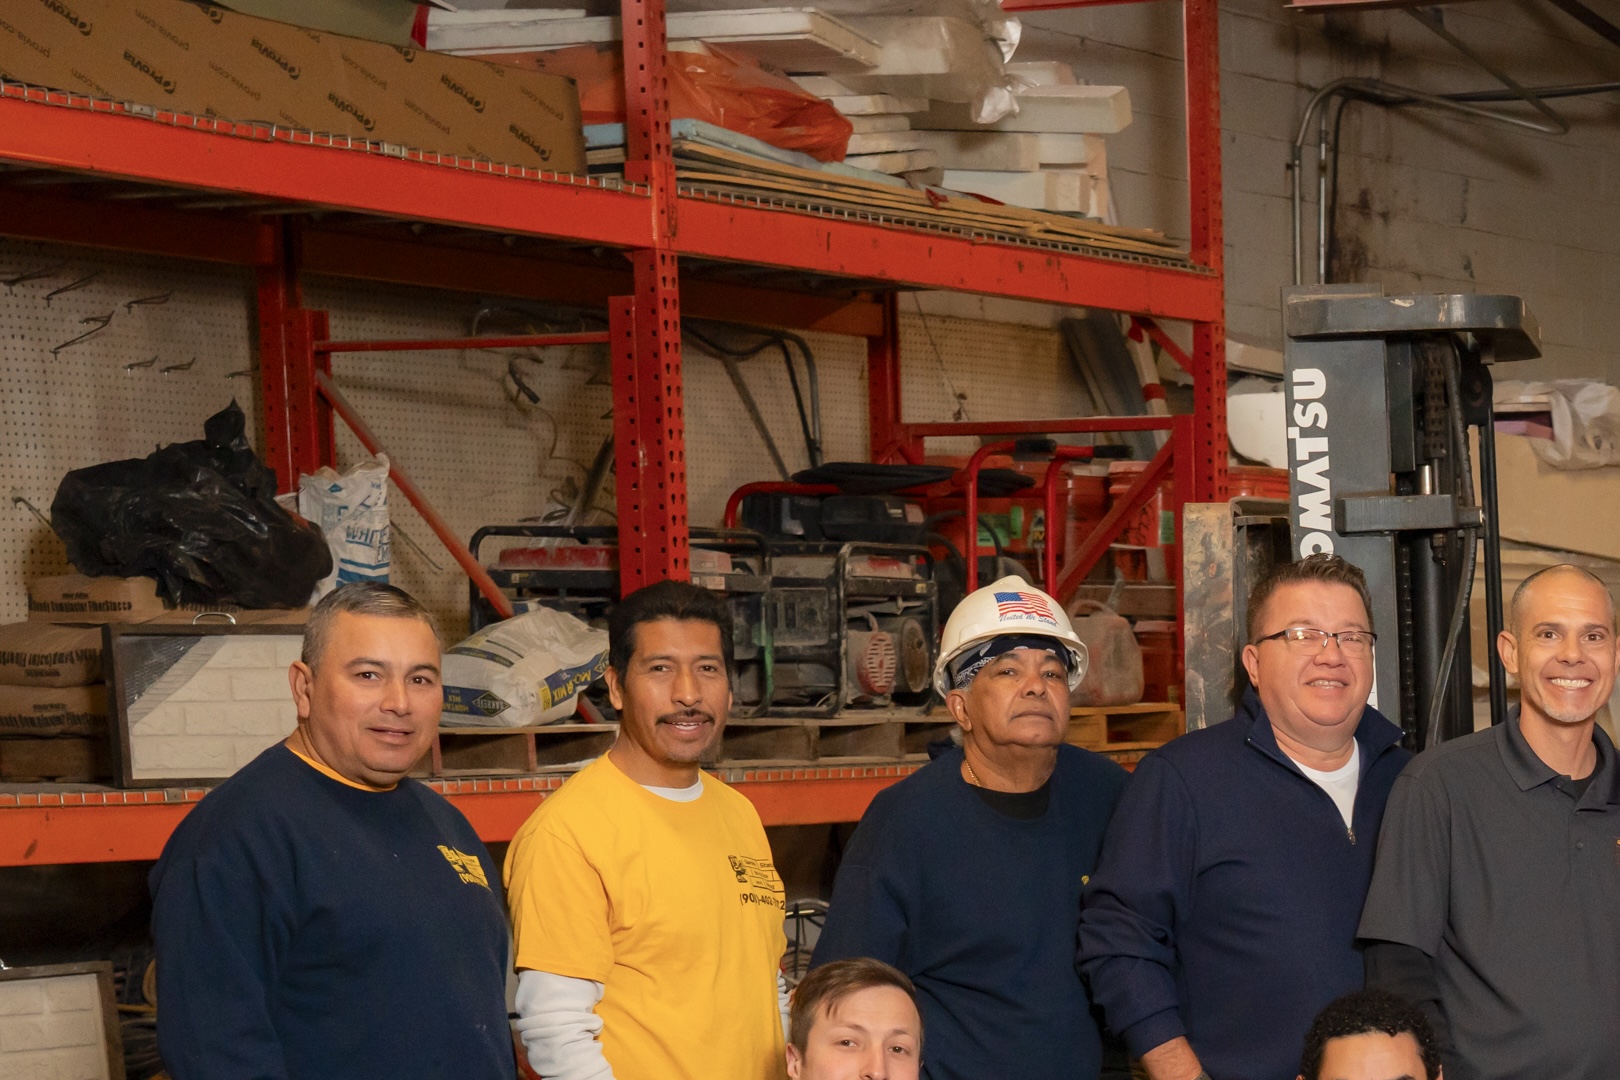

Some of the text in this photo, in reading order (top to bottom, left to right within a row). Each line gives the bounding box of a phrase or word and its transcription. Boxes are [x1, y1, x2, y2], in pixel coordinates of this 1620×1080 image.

[1288, 368, 1334, 560] OMATSU
[999, 613, 1024, 622] United
[552, 686, 567, 702] MIX
